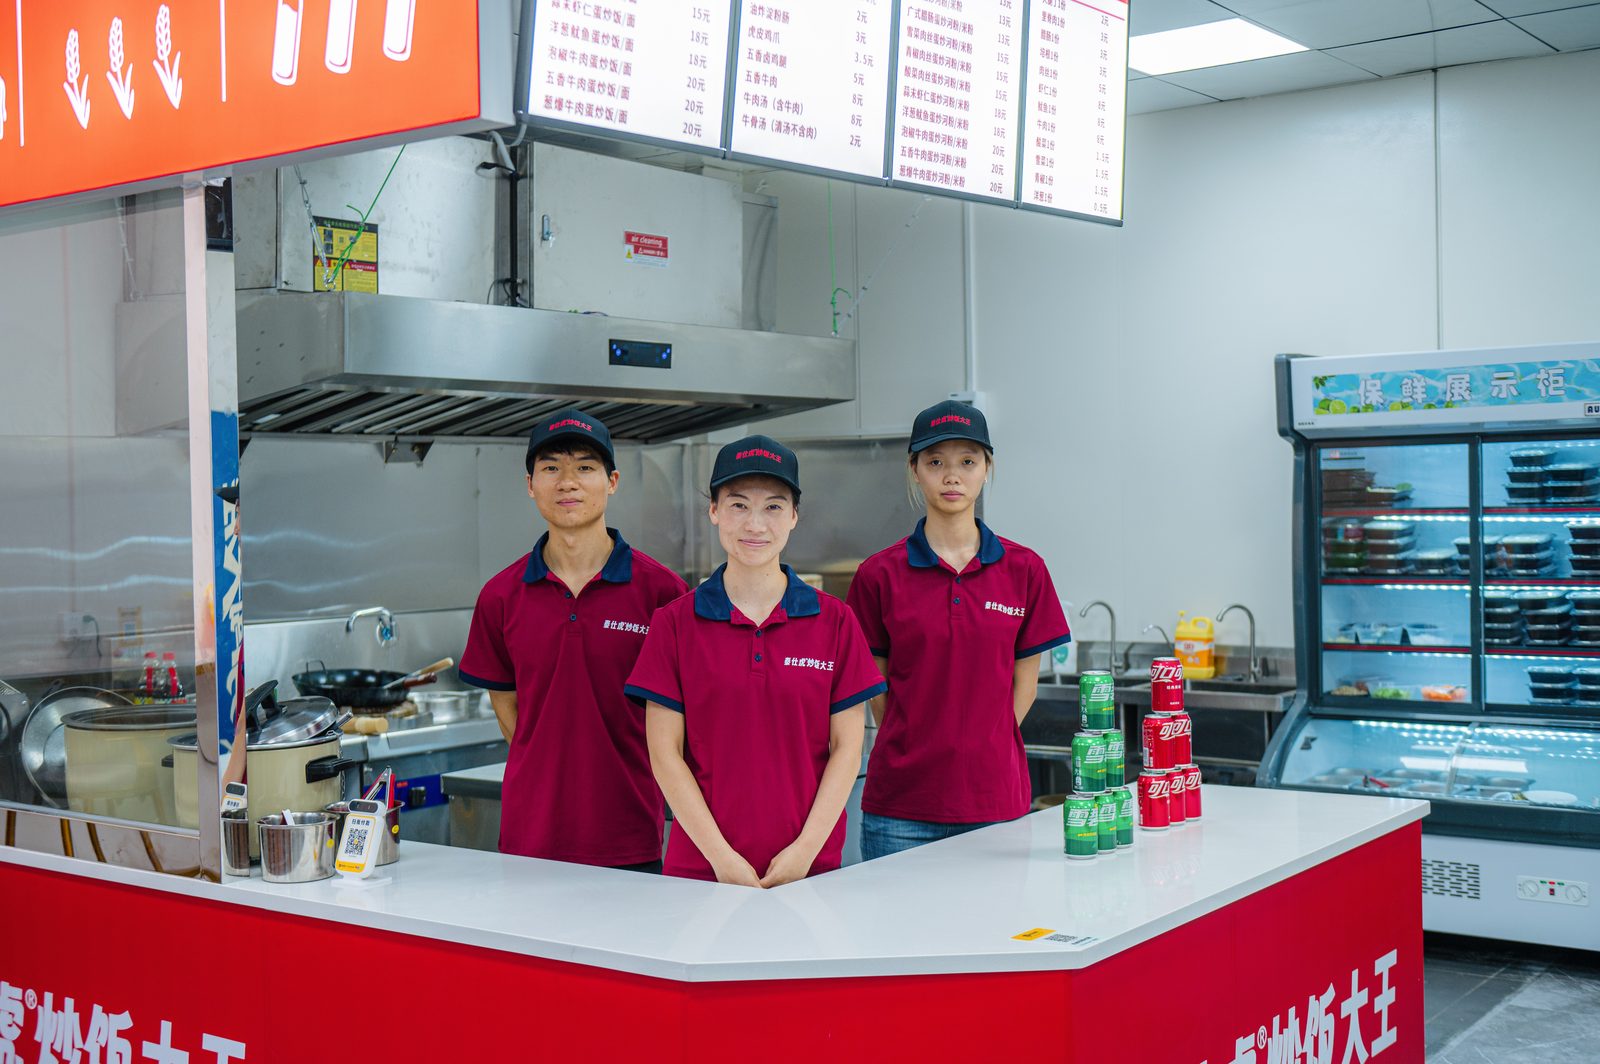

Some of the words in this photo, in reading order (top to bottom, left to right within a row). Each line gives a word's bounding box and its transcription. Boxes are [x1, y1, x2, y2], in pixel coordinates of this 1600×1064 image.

[693, 7, 711, 23] 15元
[857, 10, 867, 24] 2元
[691, 30, 709, 46] 18元
[856, 31, 866, 44] 3元
[689, 53, 707, 69] 18元
[855, 52, 874, 67] 3.5元
[687, 76, 705, 92] 20元
[853, 72, 865, 86] 5元
[546, 71, 630, 100] 五香牛肉蛋炒饭/面
[685, 99, 704, 115] 20元
[745, 70, 778, 88] 五香牛肉
[852, 93, 864, 107] 8元
[544, 95, 628, 124] 葱爆牛肉蛋炒饭/面
[682, 122, 702, 138] 20元
[850, 113, 863, 127] 8元
[849, 134, 862, 148] 2元
[992, 145, 1005, 158] 20元
[991, 163, 1004, 176] 20元
[990, 182, 1003, 195] 20元
[1357, 366, 1566, 406] 保鲜展示柜
[1089, 683, 1114, 702] 雪
